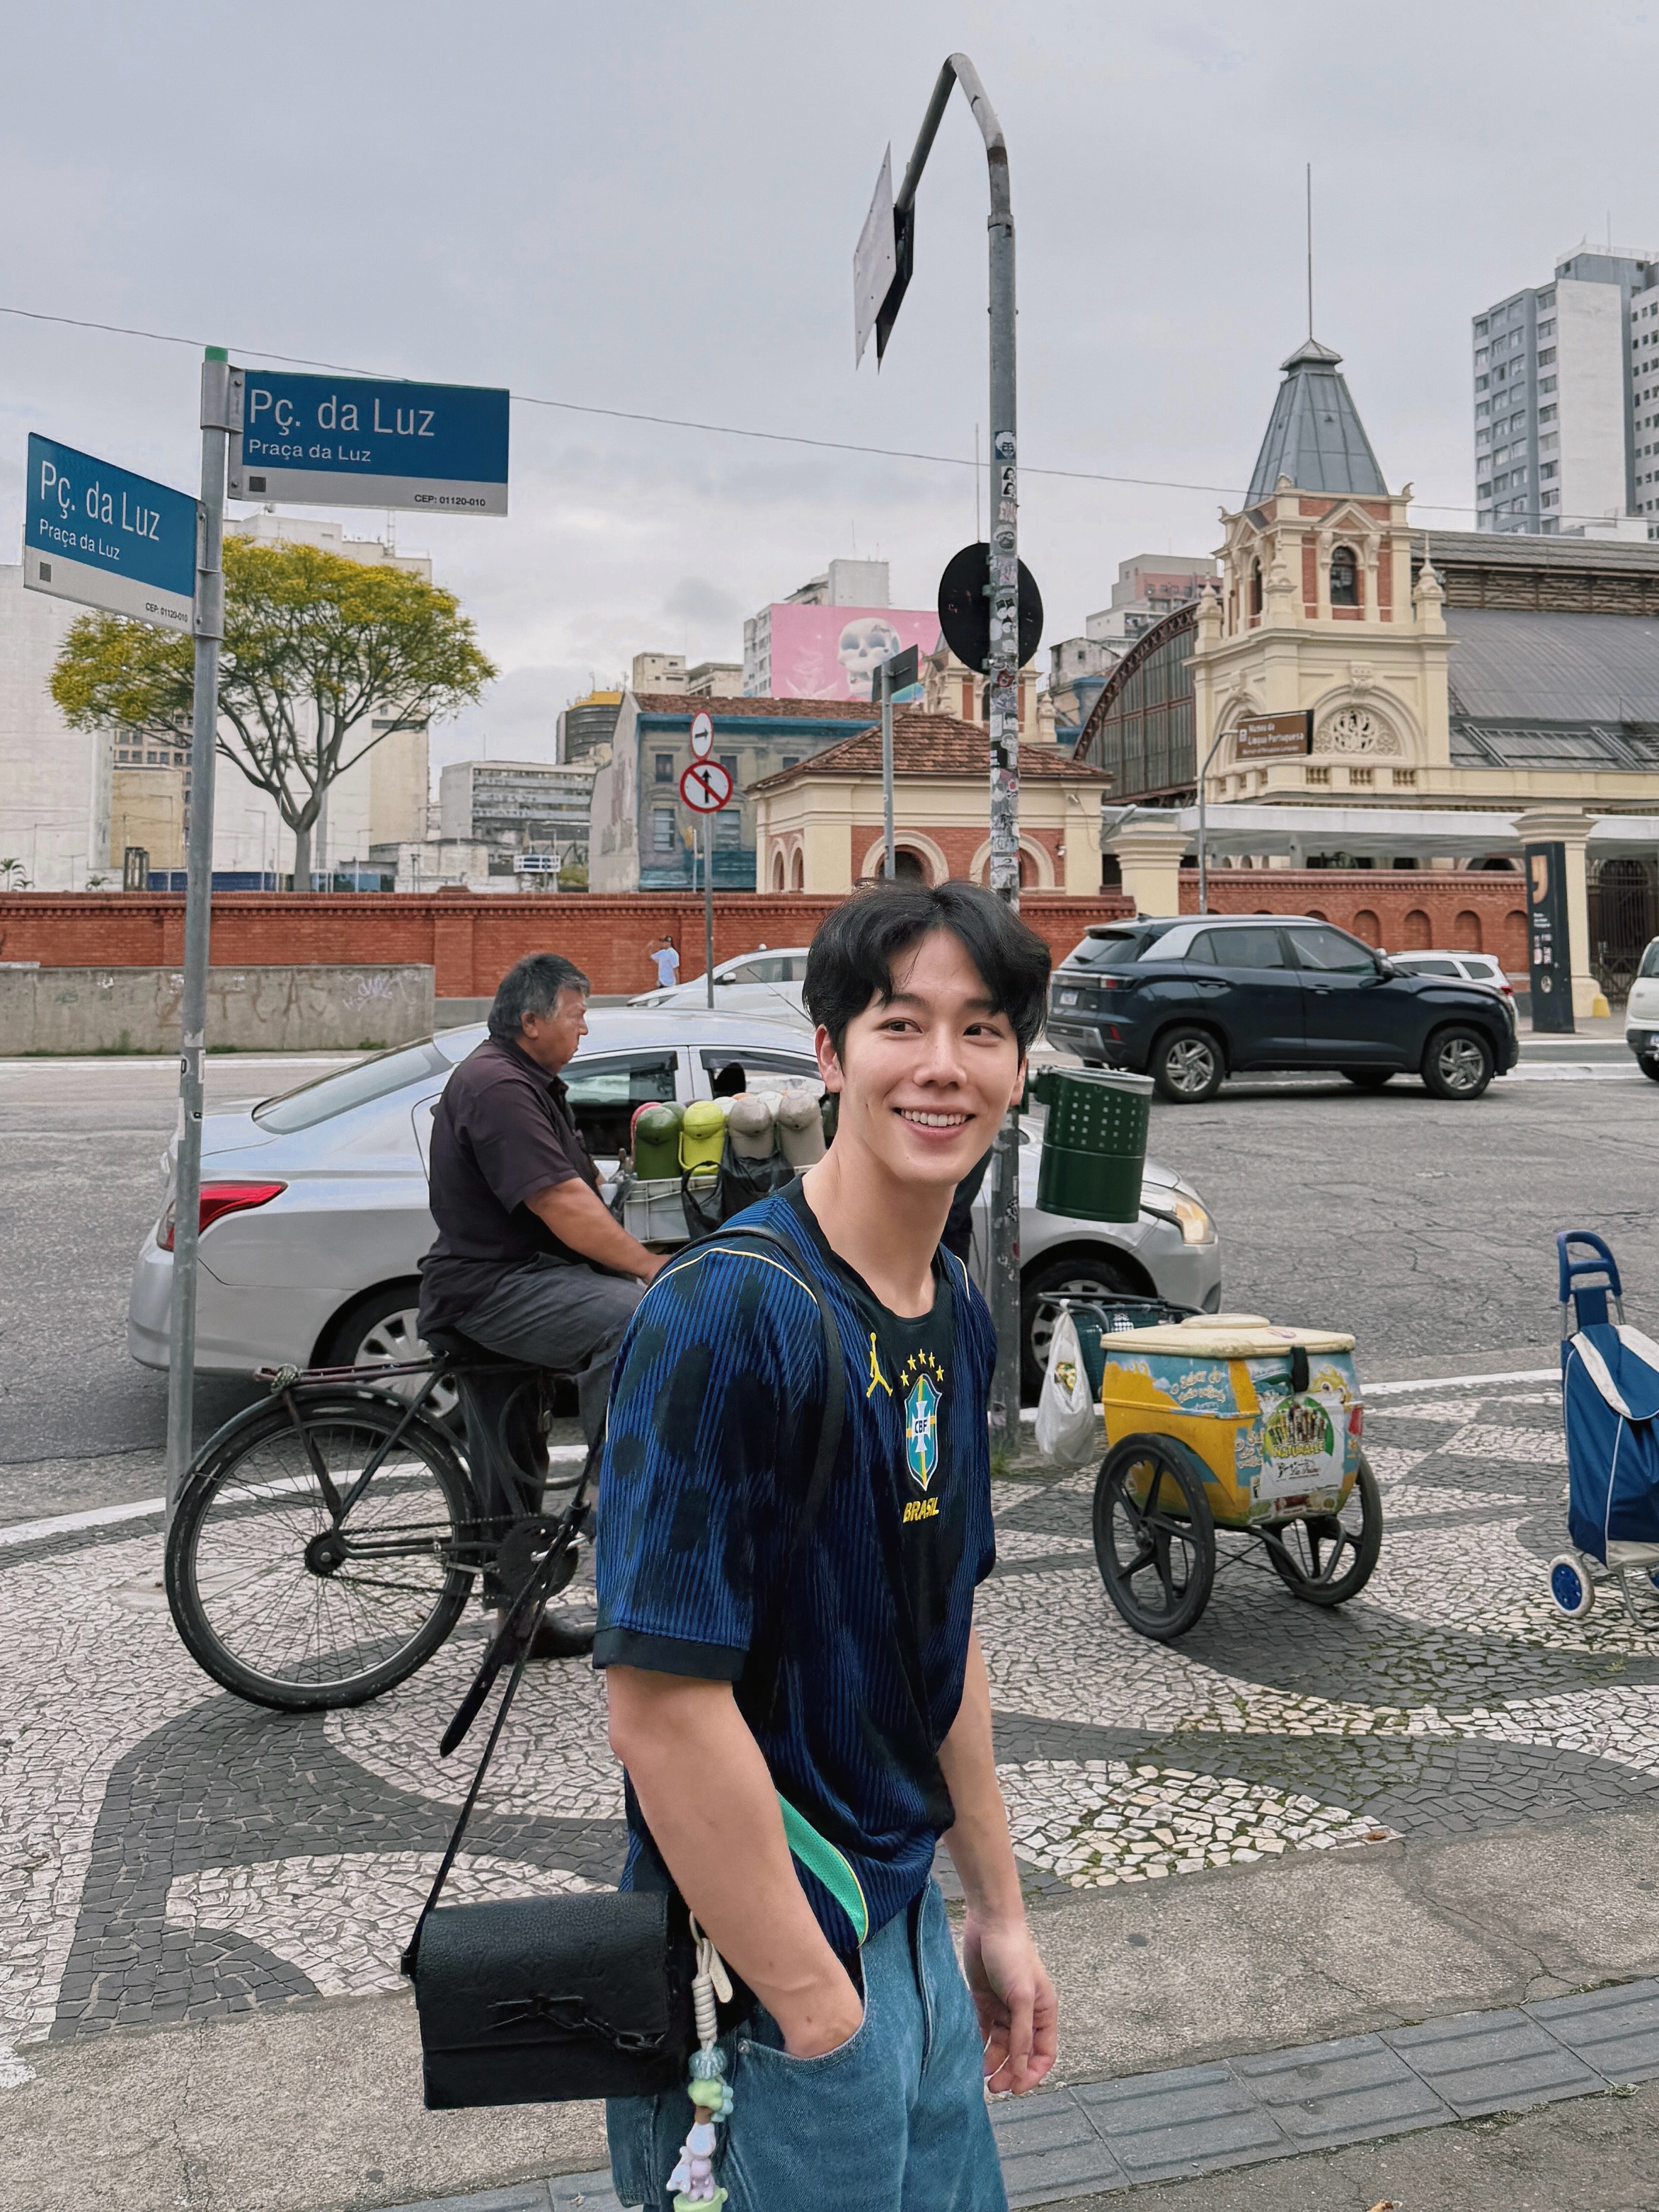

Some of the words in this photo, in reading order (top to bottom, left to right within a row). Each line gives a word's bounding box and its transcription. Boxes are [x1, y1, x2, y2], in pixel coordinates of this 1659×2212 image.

[250, 389, 302, 436] Pç.
[318, 394, 360, 431] da
[373, 397, 435, 436] Luz
[248, 438, 303, 460] Praça
[309, 444, 332, 459] da
[338, 445, 372, 462] Luz
[40, 460, 75, 520] Pç.
[86, 481, 113, 525] da
[122, 491, 160, 541] Luz
[414, 494, 437, 504] CEP:
[439, 496, 486, 507] 01120-010
[40, 518, 76, 548] Praça
[79, 534, 96, 553] da
[98, 538, 120, 561] Luz
[160, 607, 188, 623] 01120-010
[914, 1419, 928, 1434] CBF
[903, 1496, 940, 1523] BRASIL
